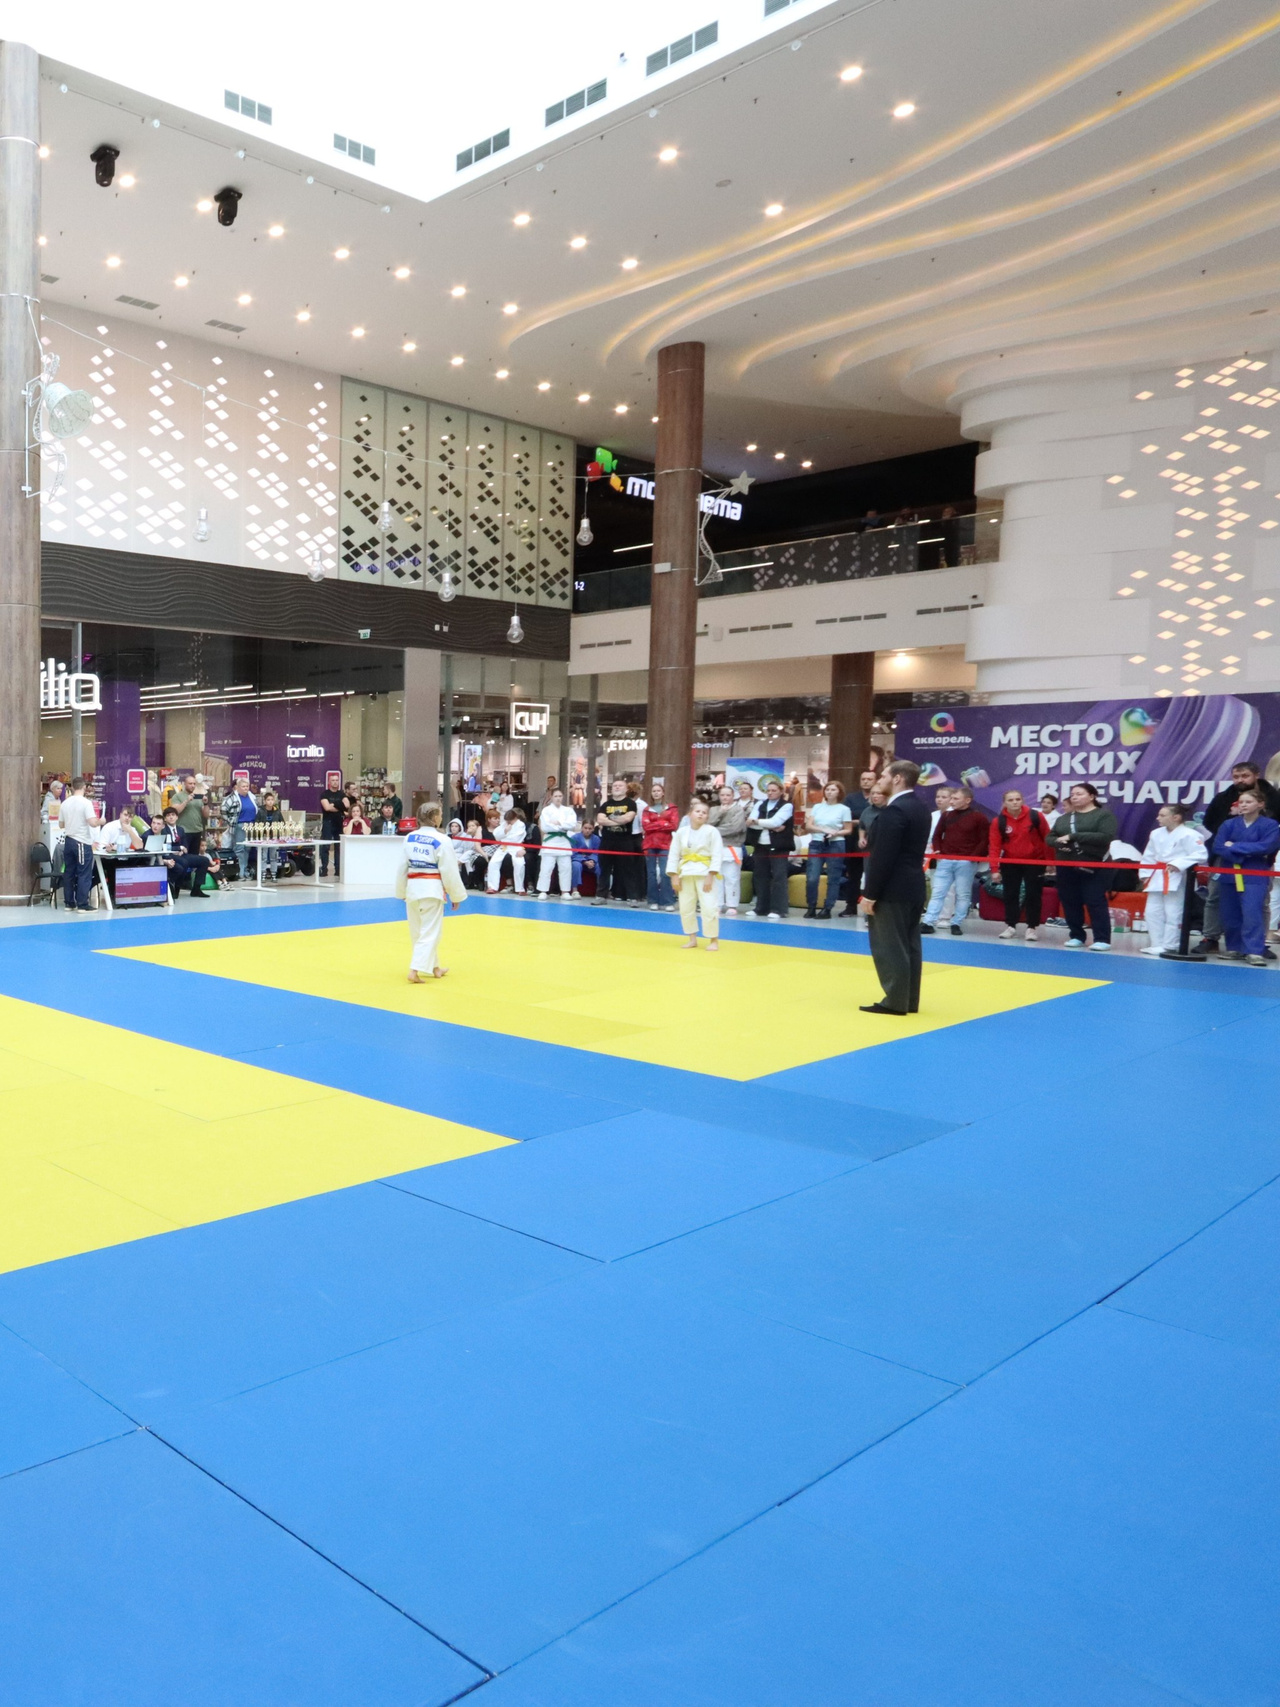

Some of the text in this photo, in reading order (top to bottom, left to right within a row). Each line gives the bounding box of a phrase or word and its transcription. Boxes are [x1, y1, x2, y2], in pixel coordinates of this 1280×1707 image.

[912, 735, 973, 745] акварель
[990, 723, 1114, 748] МЕСТО
[286, 744, 325, 758] familia
[1013, 751, 1142, 775] ЯРКИХ
[413, 846, 430, 856] RUS
